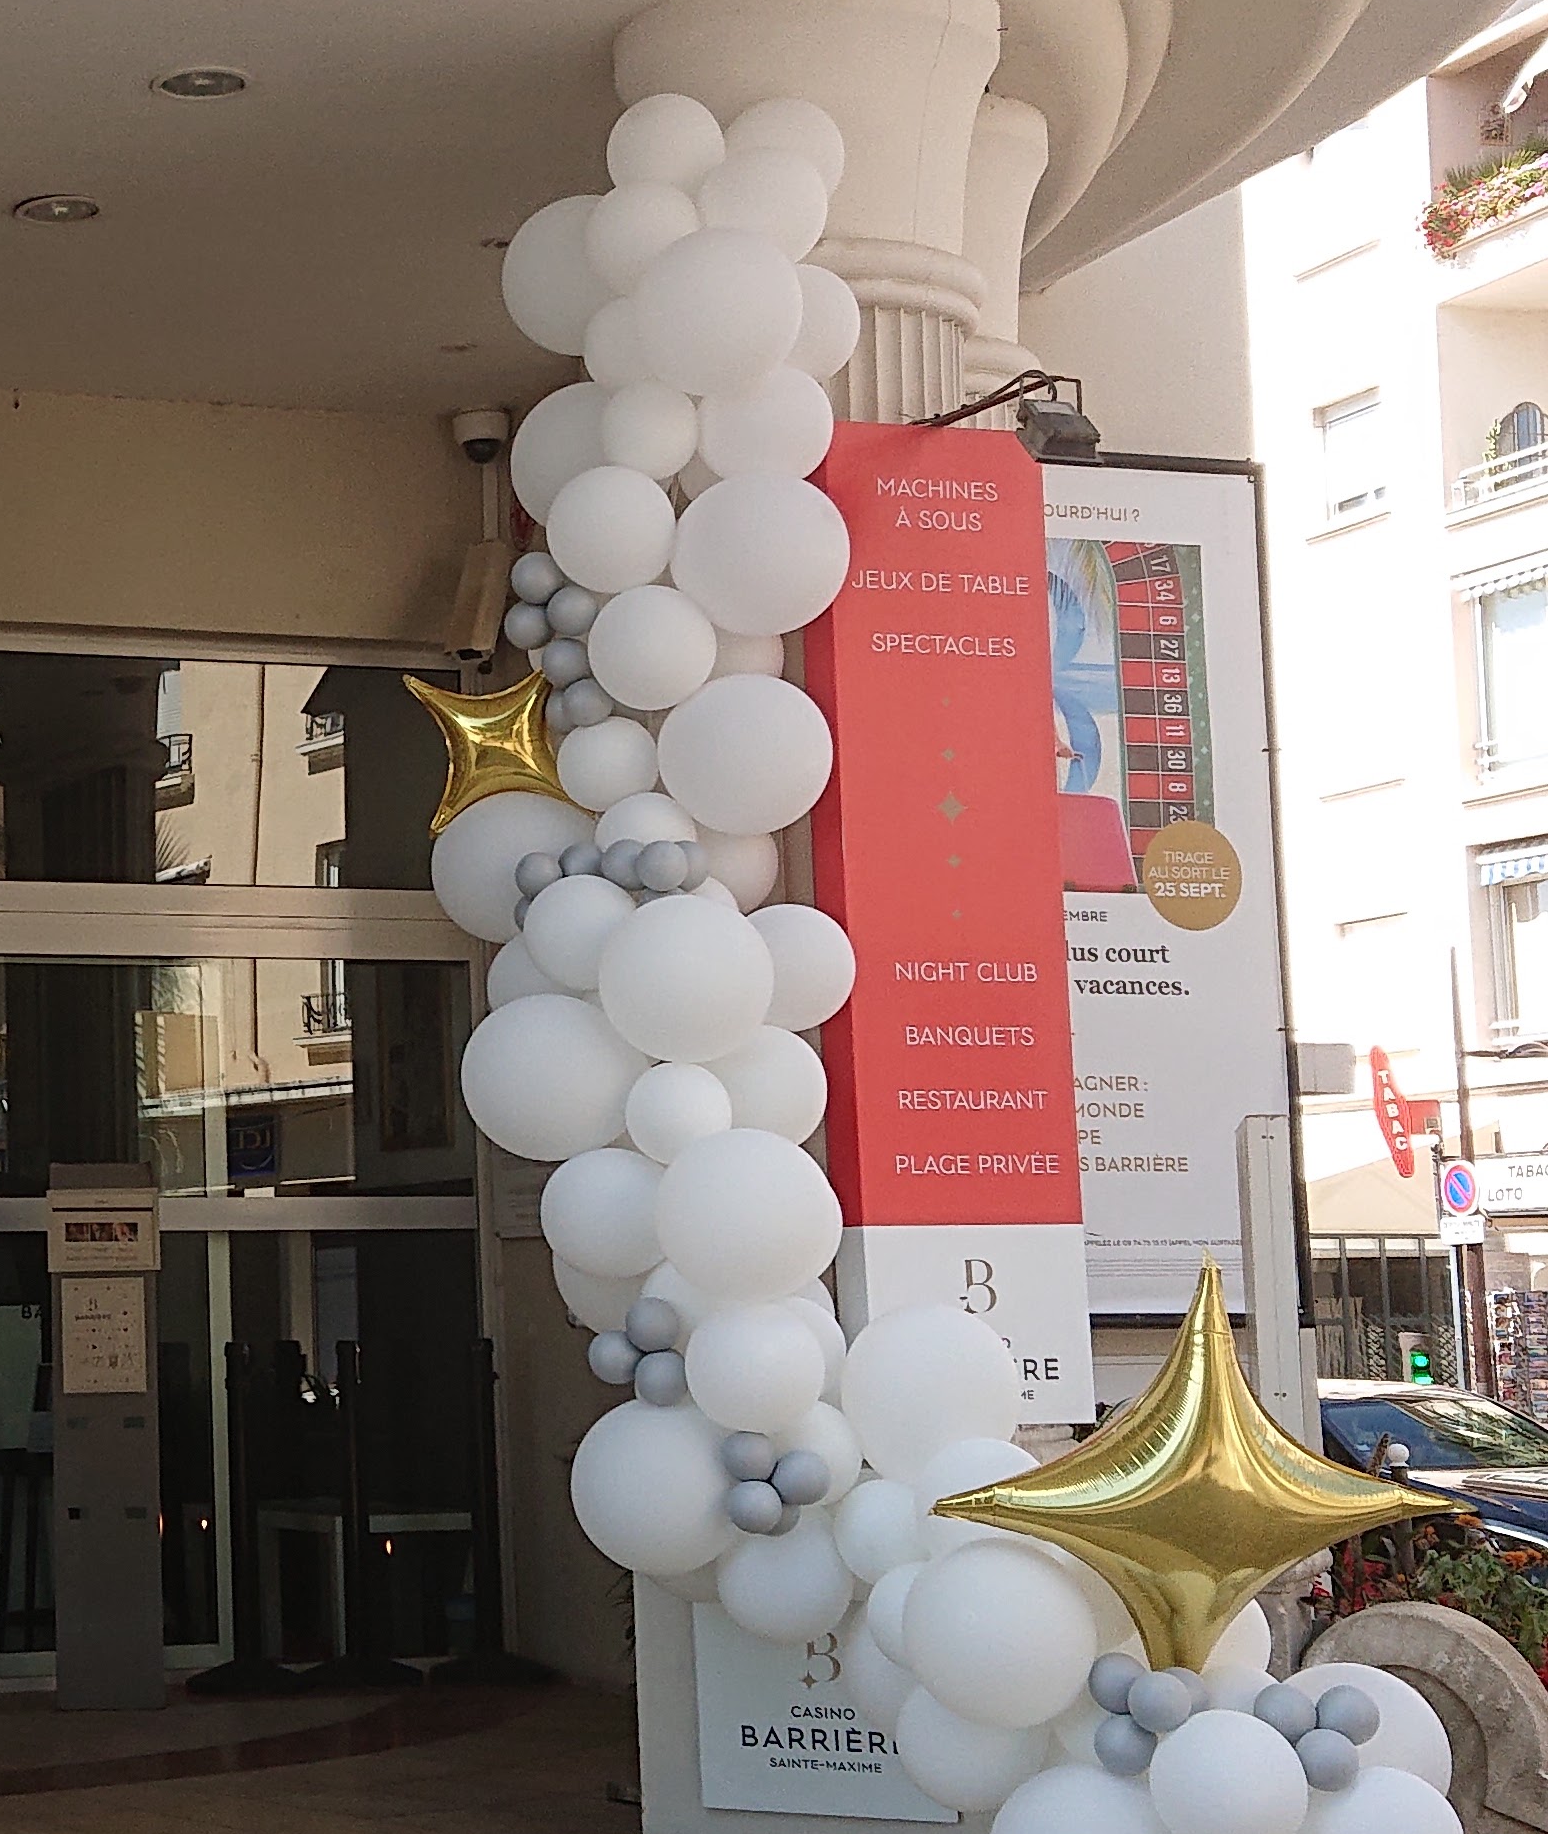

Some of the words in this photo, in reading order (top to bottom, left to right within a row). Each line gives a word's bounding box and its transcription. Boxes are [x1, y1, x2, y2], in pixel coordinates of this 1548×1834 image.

[876, 477, 999, 502] MACHINES
[894, 506, 912, 528] À
[918, 509, 983, 532] SOUS
[1150, 554, 1172, 575] 17
[851, 568, 914, 591] JEUX
[921, 572, 952, 592] DE
[958, 574, 1030, 596] TABLE
[1154, 579, 1176, 602] 34
[870, 632, 1016, 657] SPECTACLES
[1160, 639, 1180, 659] 27
[1161, 667, 1181, 684] 13
[1163, 693, 1183, 714] 36
[1165, 724, 1186, 737] 11
[1167, 749, 1187, 770] 30
[1168, 782, 1187, 793] 8
[1162, 850, 1214, 864] TIRAGE
[1148, 866, 1169, 879] AU
[1171, 867, 1210, 880] SORT
[1212, 867, 1231, 880] LE
[1154, 883, 1177, 898] 25
[1179, 883, 1227, 898] SEPT.
[1105, 945, 1171, 964] court
[894, 961, 970, 982] NIGHT
[977, 962, 1039, 983] CLUB
[1074, 978, 1191, 996] vacances.
[905, 1025, 1036, 1047] BANQUETS
[898, 1089, 1049, 1111] RESTAURANT
[1377, 1069, 1408, 1151] TABAC
[895, 1154, 972, 1175] PLAGE
[978, 1151, 1060, 1175] PRIVÉE
[1095, 1154, 1190, 1173] BARRIÈRE
[1488, 1187, 1523, 1202] LOTO
[790, 1705, 856, 1721] CASINO
[740, 1725, 900, 1755] BARRIÈR
[769, 1756, 883, 1774] SAINTE-MAXIME
